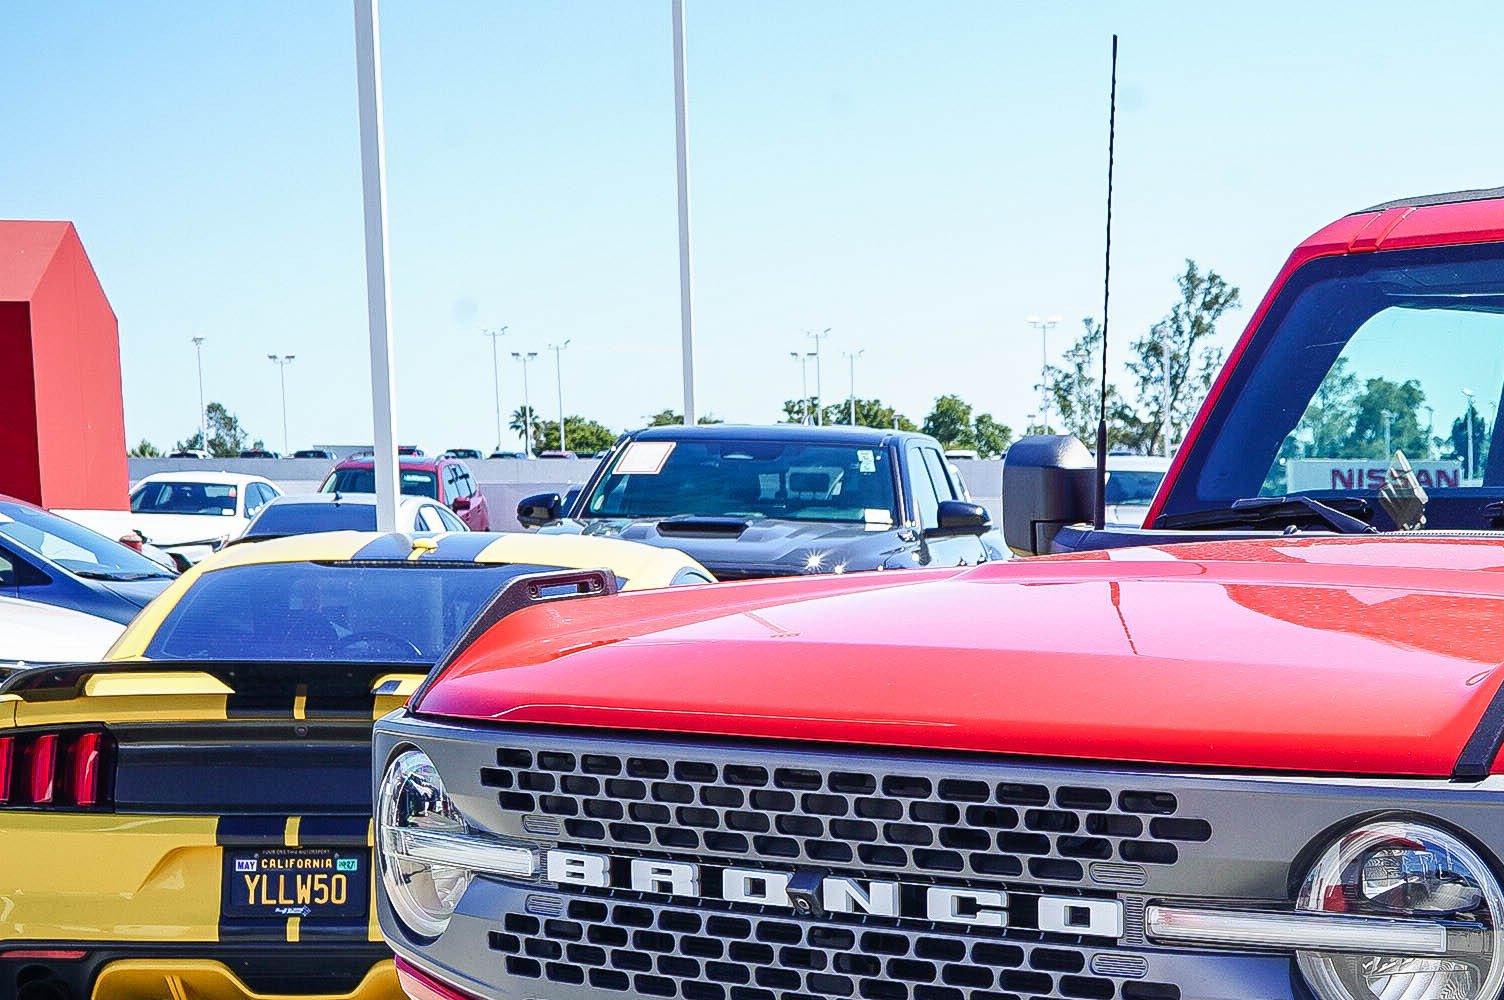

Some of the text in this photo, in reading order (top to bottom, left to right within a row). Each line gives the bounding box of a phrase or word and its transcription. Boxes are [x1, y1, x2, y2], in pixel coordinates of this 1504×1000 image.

[237, 860, 256, 870] MAY
[261, 858, 333, 869] CALIFORNIA
[244, 874, 347, 905] YLLW50
[546, 848, 1125, 938] BRONCO
